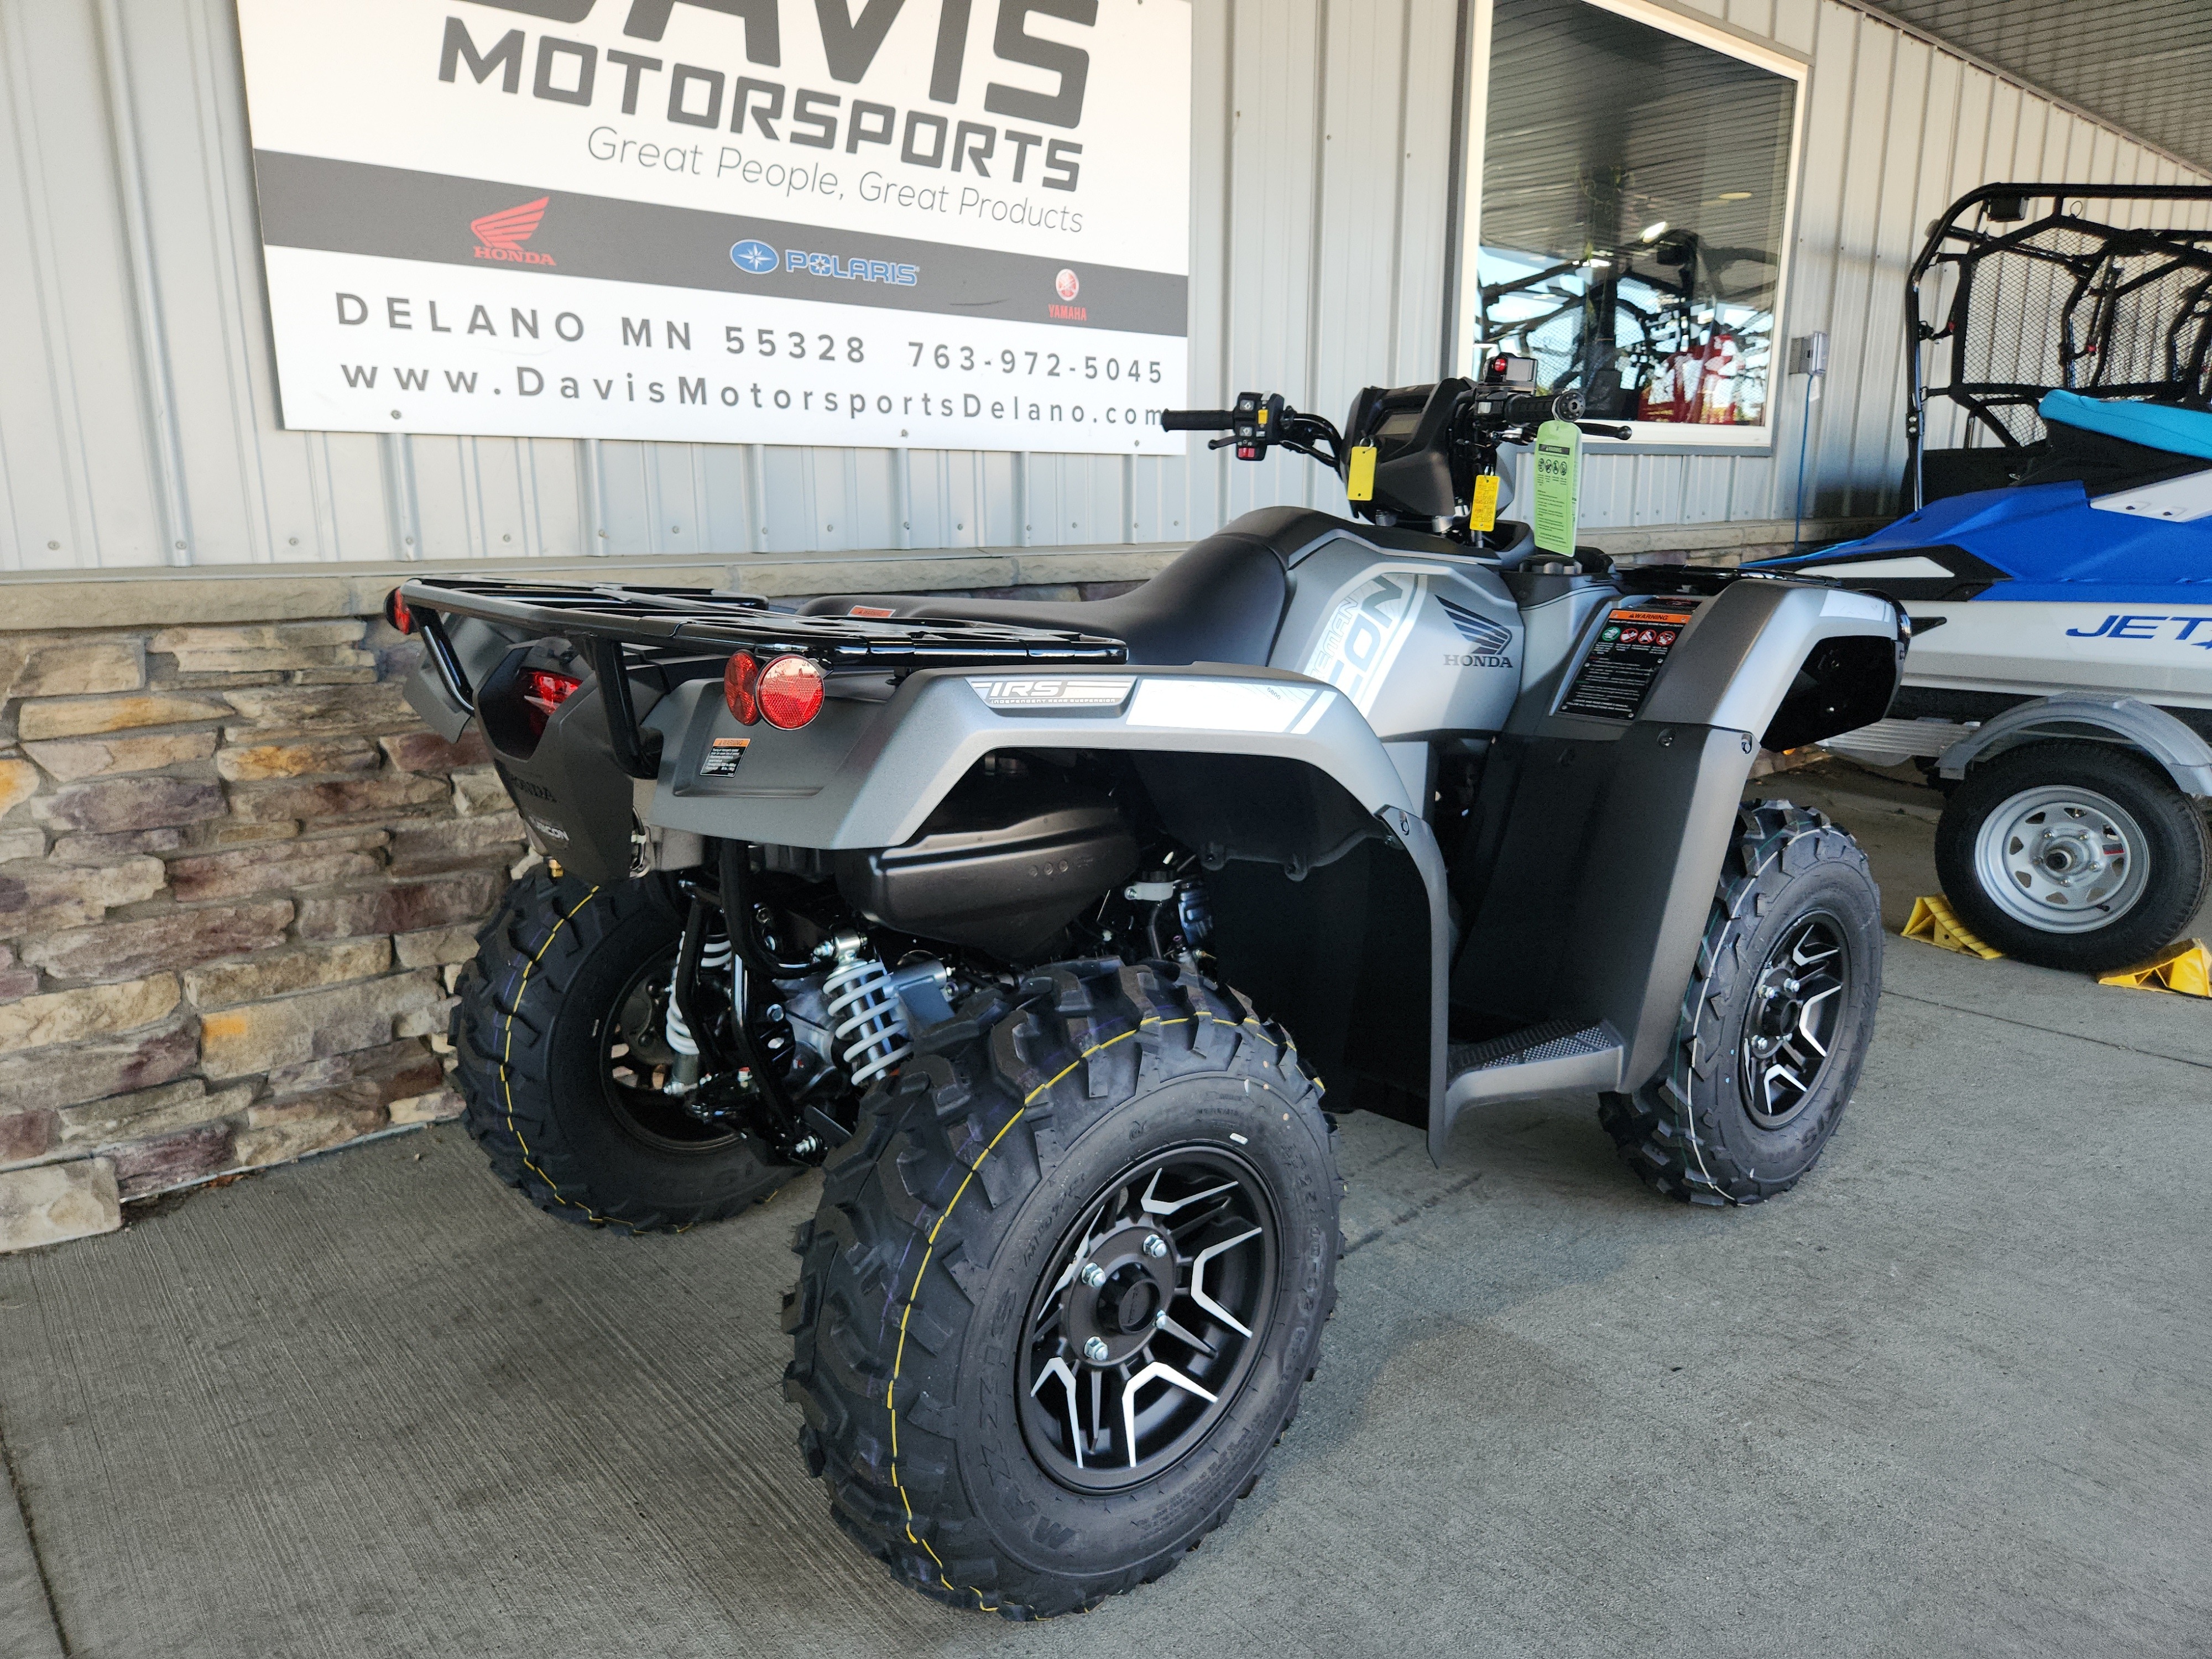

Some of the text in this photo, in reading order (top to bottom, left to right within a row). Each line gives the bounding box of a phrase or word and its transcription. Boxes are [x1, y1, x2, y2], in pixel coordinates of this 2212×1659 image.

[439, 15, 1083, 192] MOTORSPORTS
[587, 126, 1083, 233] Great People, Great Products
[473, 246, 556, 266] HONDA
[785, 249, 918, 286] POLARIS
[1048, 304, 1088, 321] YAMAHA
[335, 292, 1162, 383] DELANO MN 55328 763-972-5045
[340, 364, 1164, 426] www.DavisMotorsportsDelano.com
[1633, 613, 1669, 621] WARNING
[2065, 615, 2212, 640] JET
[1443, 654, 1513, 669] HONDA
[990, 681, 1062, 697] IRS
[1267, 687, 1281, 700] 6800
